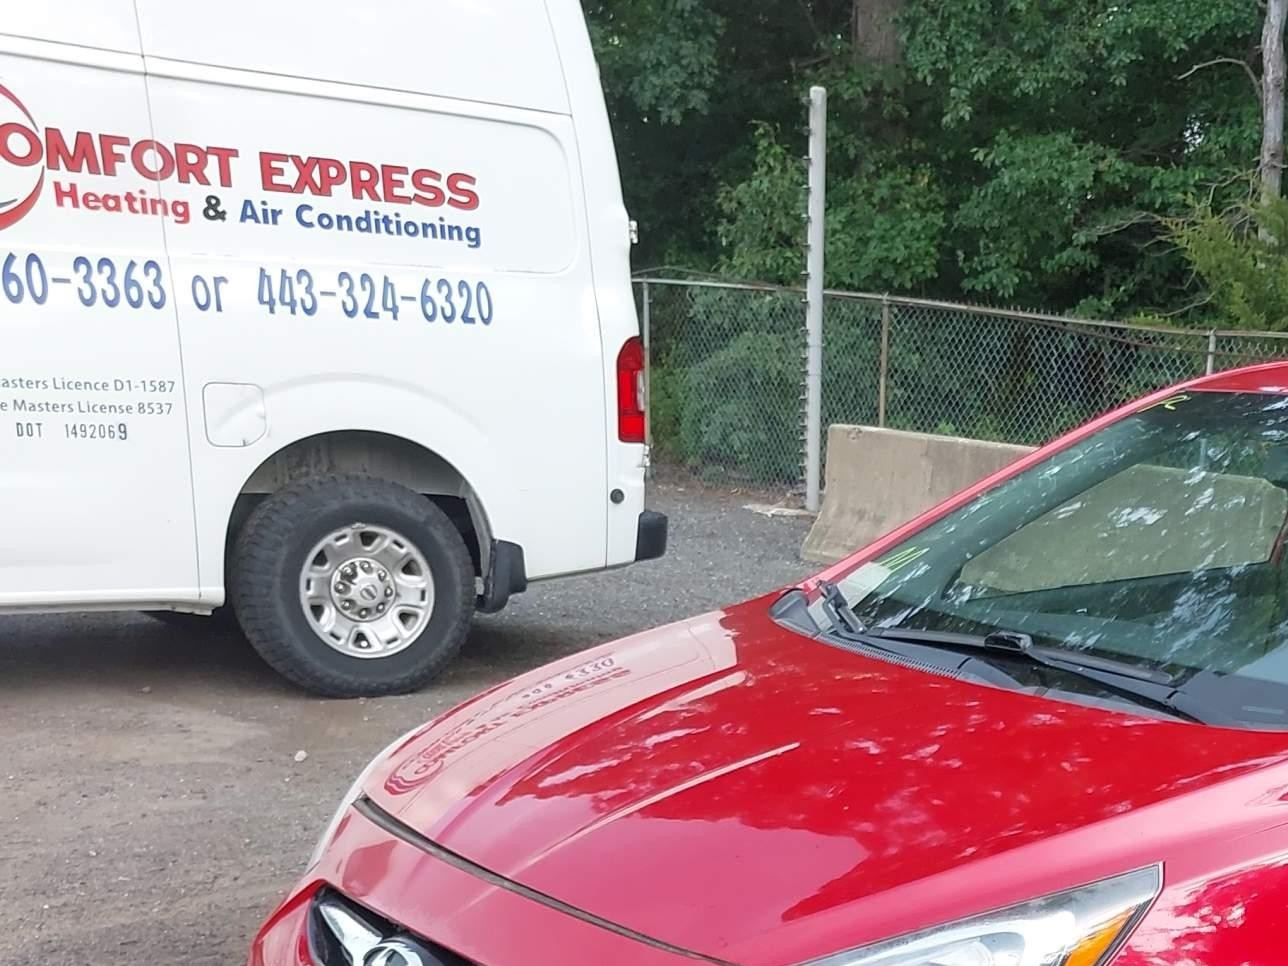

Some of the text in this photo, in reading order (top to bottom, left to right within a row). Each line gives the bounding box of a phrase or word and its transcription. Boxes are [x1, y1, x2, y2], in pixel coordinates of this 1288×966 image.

[259, 151, 480, 211] EXPRESS
[53, 182, 482, 249] Heating & Air Conditioning
[1, 252, 494, 326] 60-3363 or 443-324-6320
[52, 377, 109, 392] Licence
[113, 379, 175, 393] D1-1587
[13, 399, 74, 414] Masters
[78, 401, 134, 415] License
[137, 402, 173, 415] 8537
[16, 422, 128, 441] DOT 1492069
